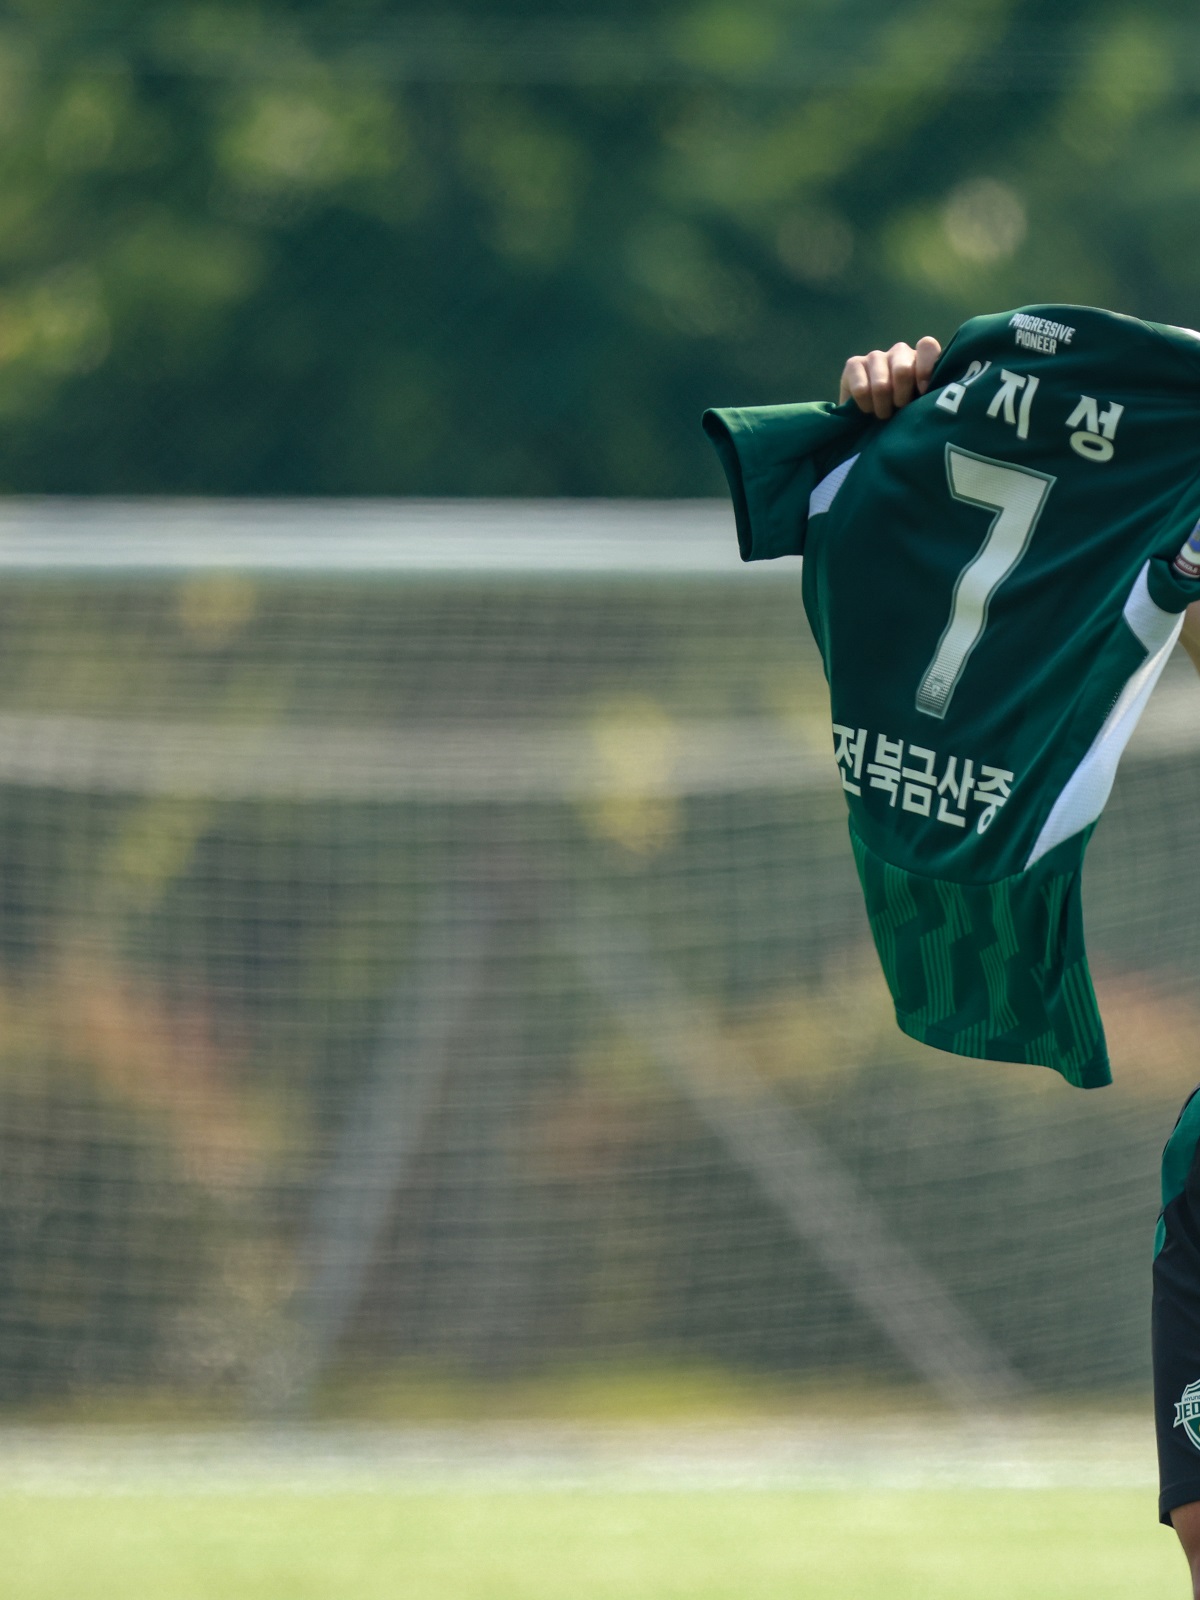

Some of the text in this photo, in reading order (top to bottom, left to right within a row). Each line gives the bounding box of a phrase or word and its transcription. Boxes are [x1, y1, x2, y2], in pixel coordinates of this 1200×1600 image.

[1008, 313, 1076, 345] PROGRESSIVE
[1015, 329, 1057, 355] PIONEER
[915, 442, 1057, 719] 7
[832, 723, 1014, 835] 전북금산중
